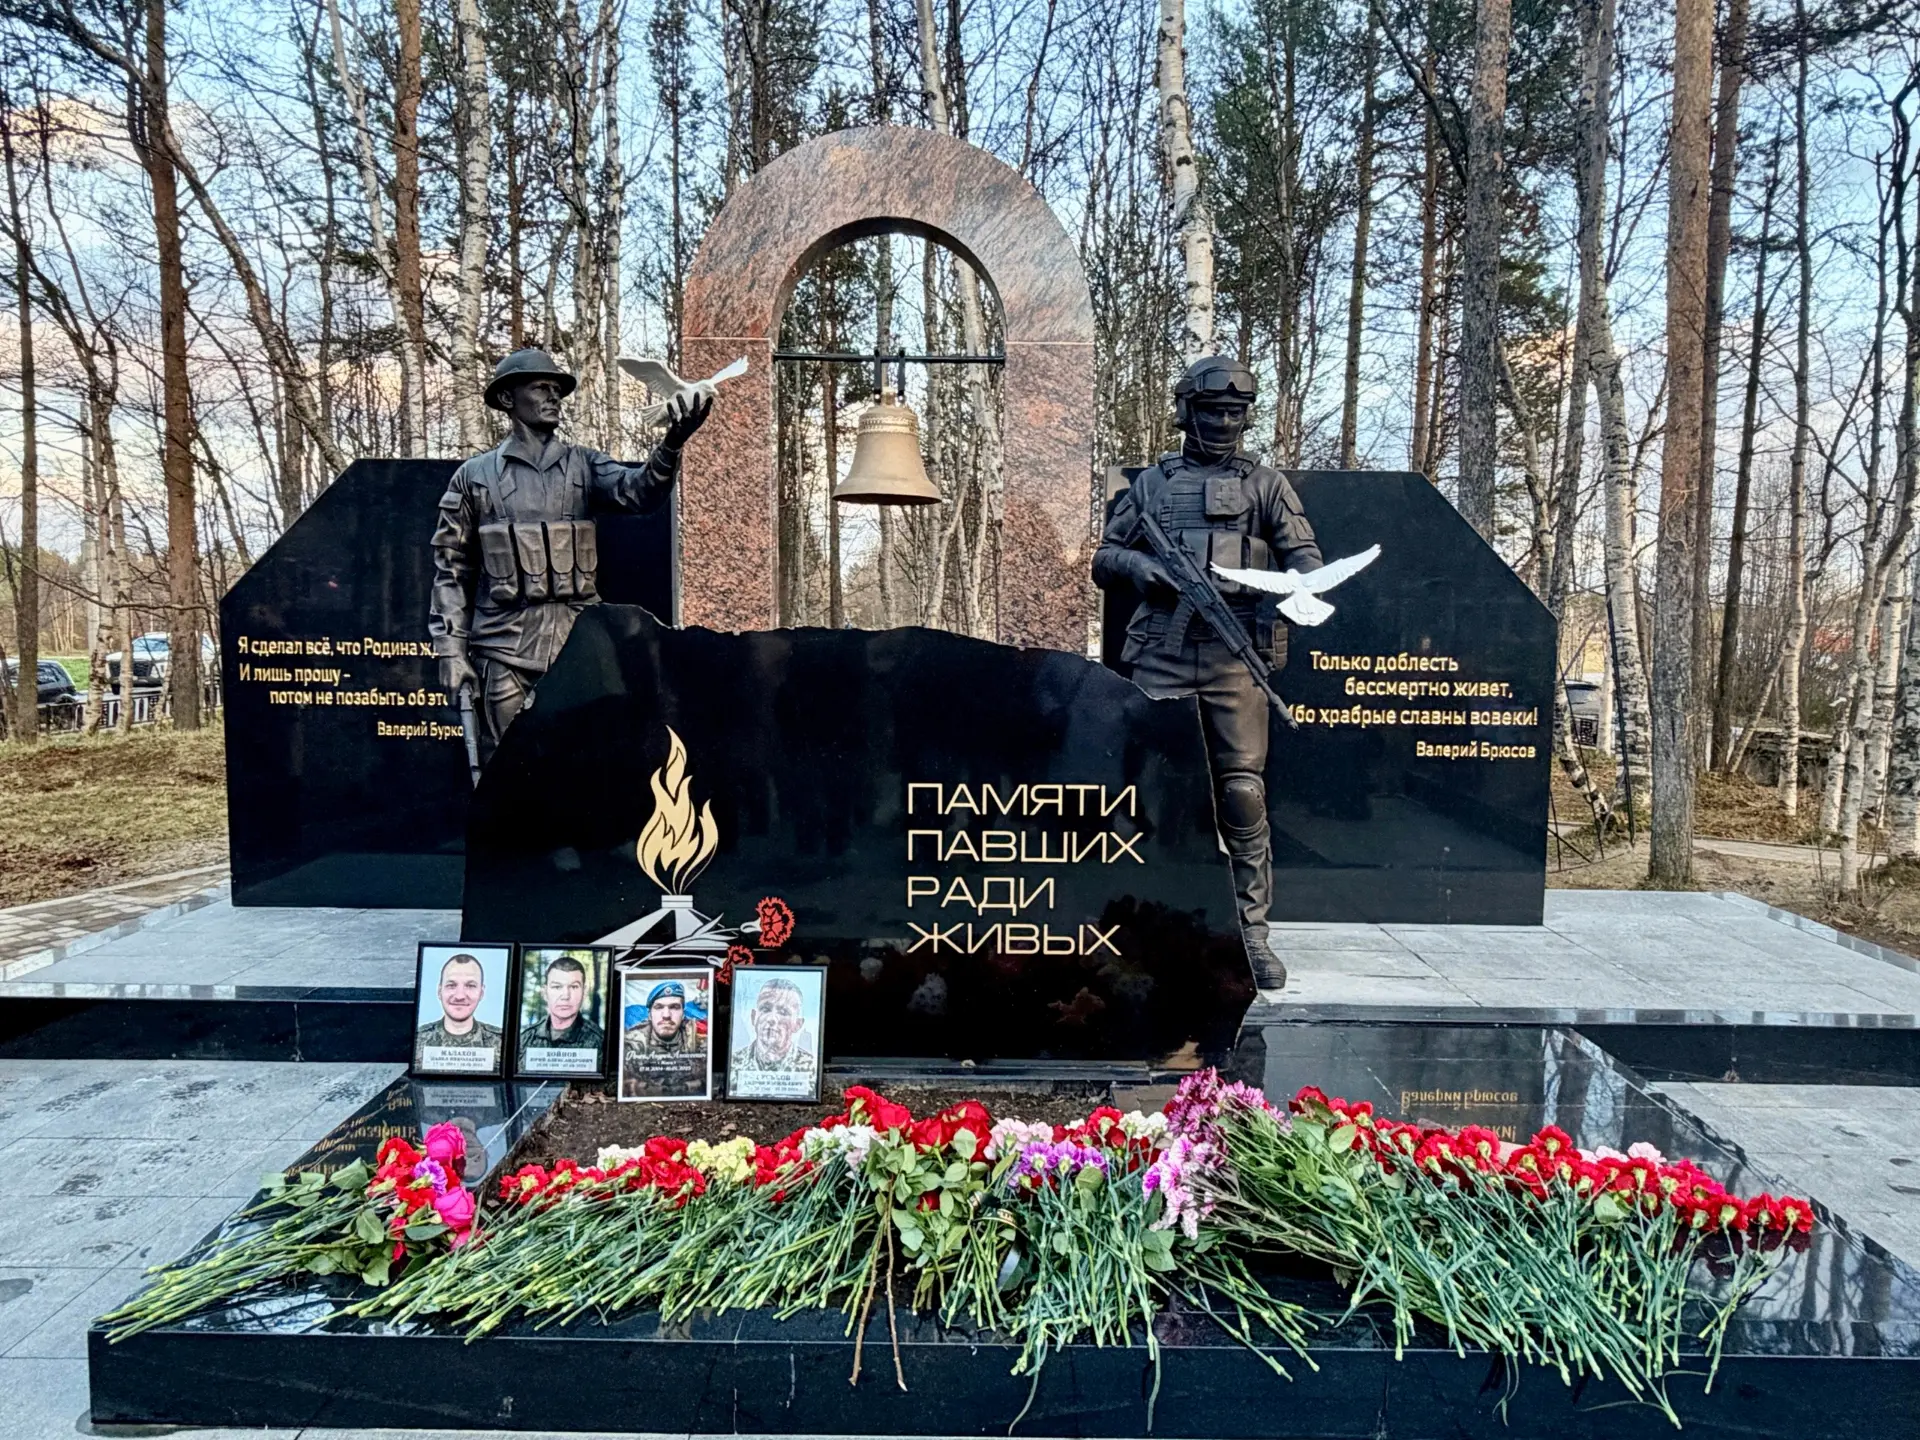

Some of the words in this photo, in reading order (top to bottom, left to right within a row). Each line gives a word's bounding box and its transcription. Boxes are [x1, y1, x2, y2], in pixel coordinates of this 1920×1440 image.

[237, 636, 249, 654] Я
[251, 640, 303, 657] сделал
[305, 636, 334, 657] всё,
[336, 641, 361, 656] что
[364, 637, 418, 659] Родина
[1310, 651, 1371, 671] Только
[1374, 652, 1459, 674] доблесть
[239, 663, 250, 681] И
[253, 667, 292, 682] лишь
[295, 668, 341, 687] прошу
[270, 690, 312, 705] потом
[315, 692, 334, 705] не
[336, 688, 405, 706] позабыть
[408, 688, 425, 706] об
[1345, 677, 1450, 701] бессмертно
[1453, 681, 1513, 699] живет,
[1319, 704, 1397, 729] храбрые
[1400, 709, 1467, 725] славны
[1470, 707, 1538, 726] вовеки!
[377, 720, 428, 740] Валерий
[430, 721, 464, 740] Бурко
[1416, 740, 1478, 761] Валерий
[1480, 741, 1536, 761] Брюсов
[908, 783, 1136, 817] ПАМЯТИ
[908, 830, 1145, 864] ПАВШИХ
[907, 876, 1055, 917] РАДИ
[906, 922, 1122, 956] ЖИВЫХ
